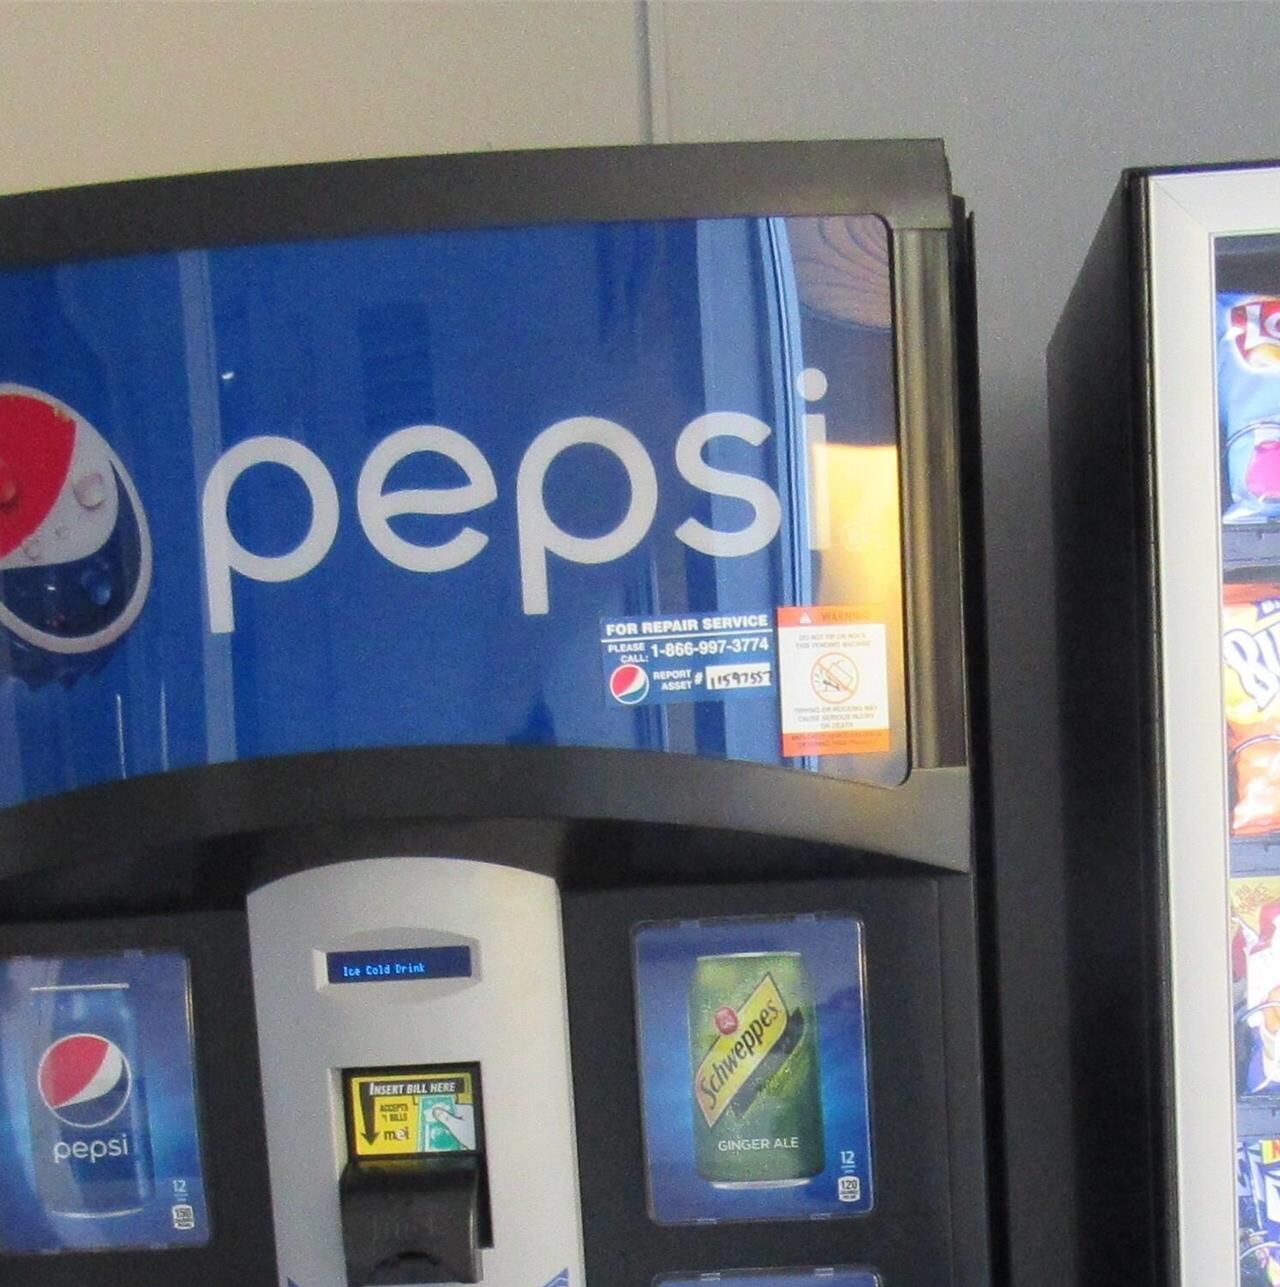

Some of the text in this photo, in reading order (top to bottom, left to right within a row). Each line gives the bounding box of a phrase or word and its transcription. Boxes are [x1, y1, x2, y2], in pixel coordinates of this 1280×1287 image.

[202, 367, 829, 633] pepsi
[606, 614, 768, 636] FOR REPAIR SERVICE
[608, 643, 645, 653] PLEASE
[651, 638, 769, 659] 1-866-997-3774
[620, 653, 649, 664] CALL:
[653, 670, 691, 681] REPORT
[694, 671, 704, 686] #
[661, 680, 691, 691] ASSET
[343, 962, 425, 977] Ice Cold Drink
[700, 998, 780, 1111] Schweppes
[369, 1082, 456, 1096] INSERT BILL HERE
[53, 1134, 129, 1164] pepsi
[718, 1136, 800, 1152] GINGER ALE
[840, 1150, 856, 1165] 12
[172, 1180, 187, 1193] 12
